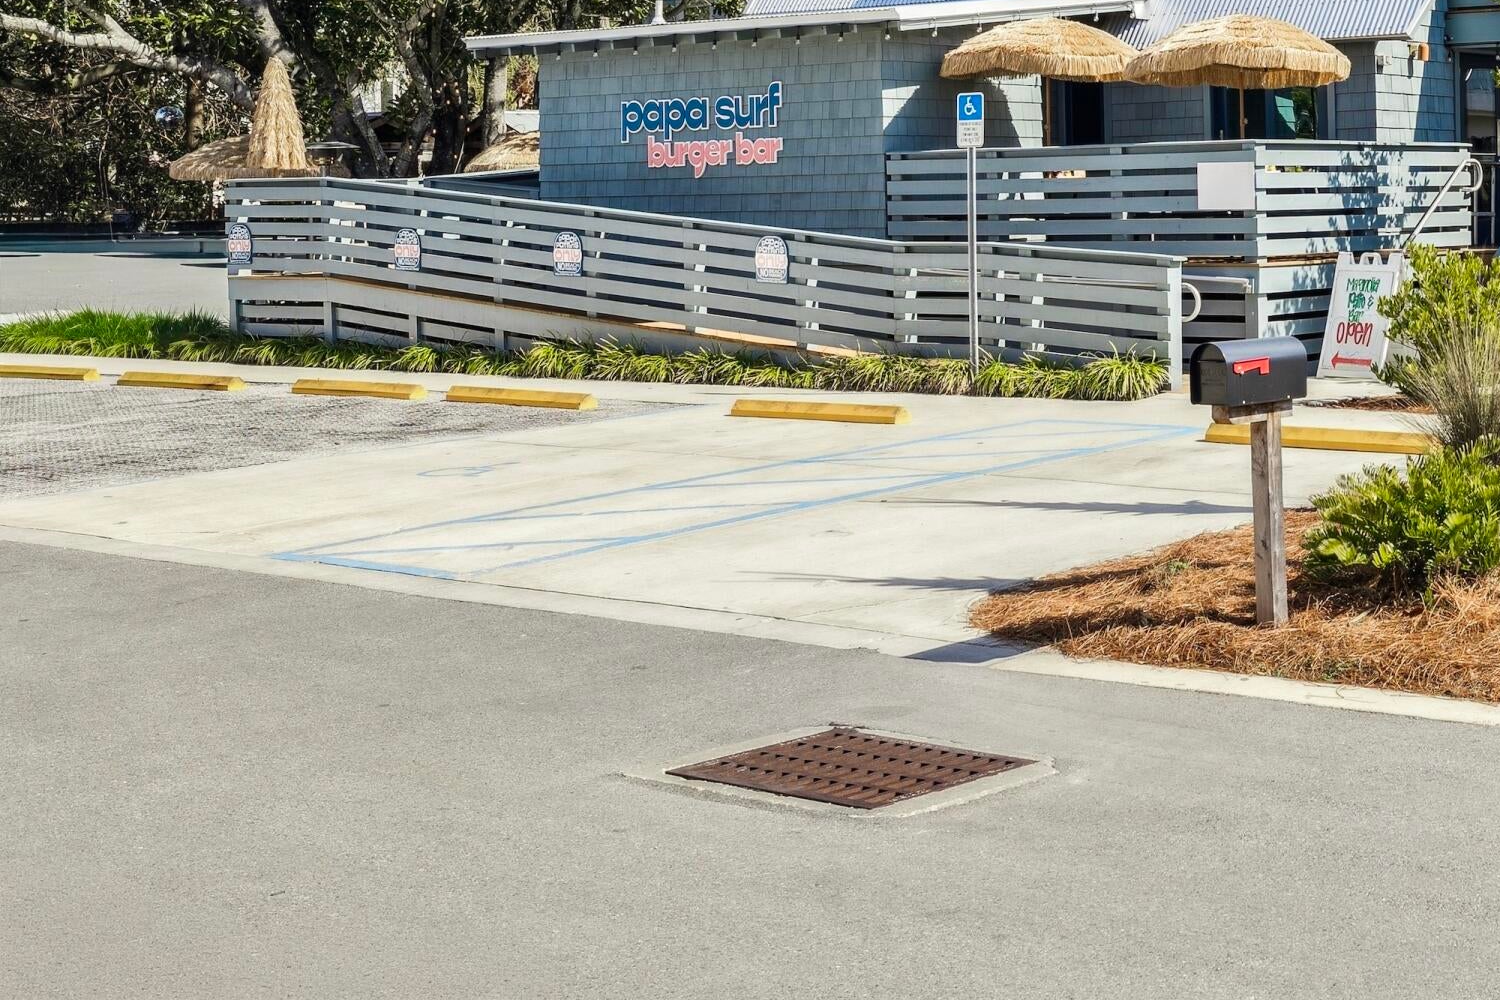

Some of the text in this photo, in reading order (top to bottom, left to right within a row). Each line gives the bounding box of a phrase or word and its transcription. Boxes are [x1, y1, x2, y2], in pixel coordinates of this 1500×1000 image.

[621, 81, 782, 143] papa surf
[648, 132, 784, 178] burger bar
